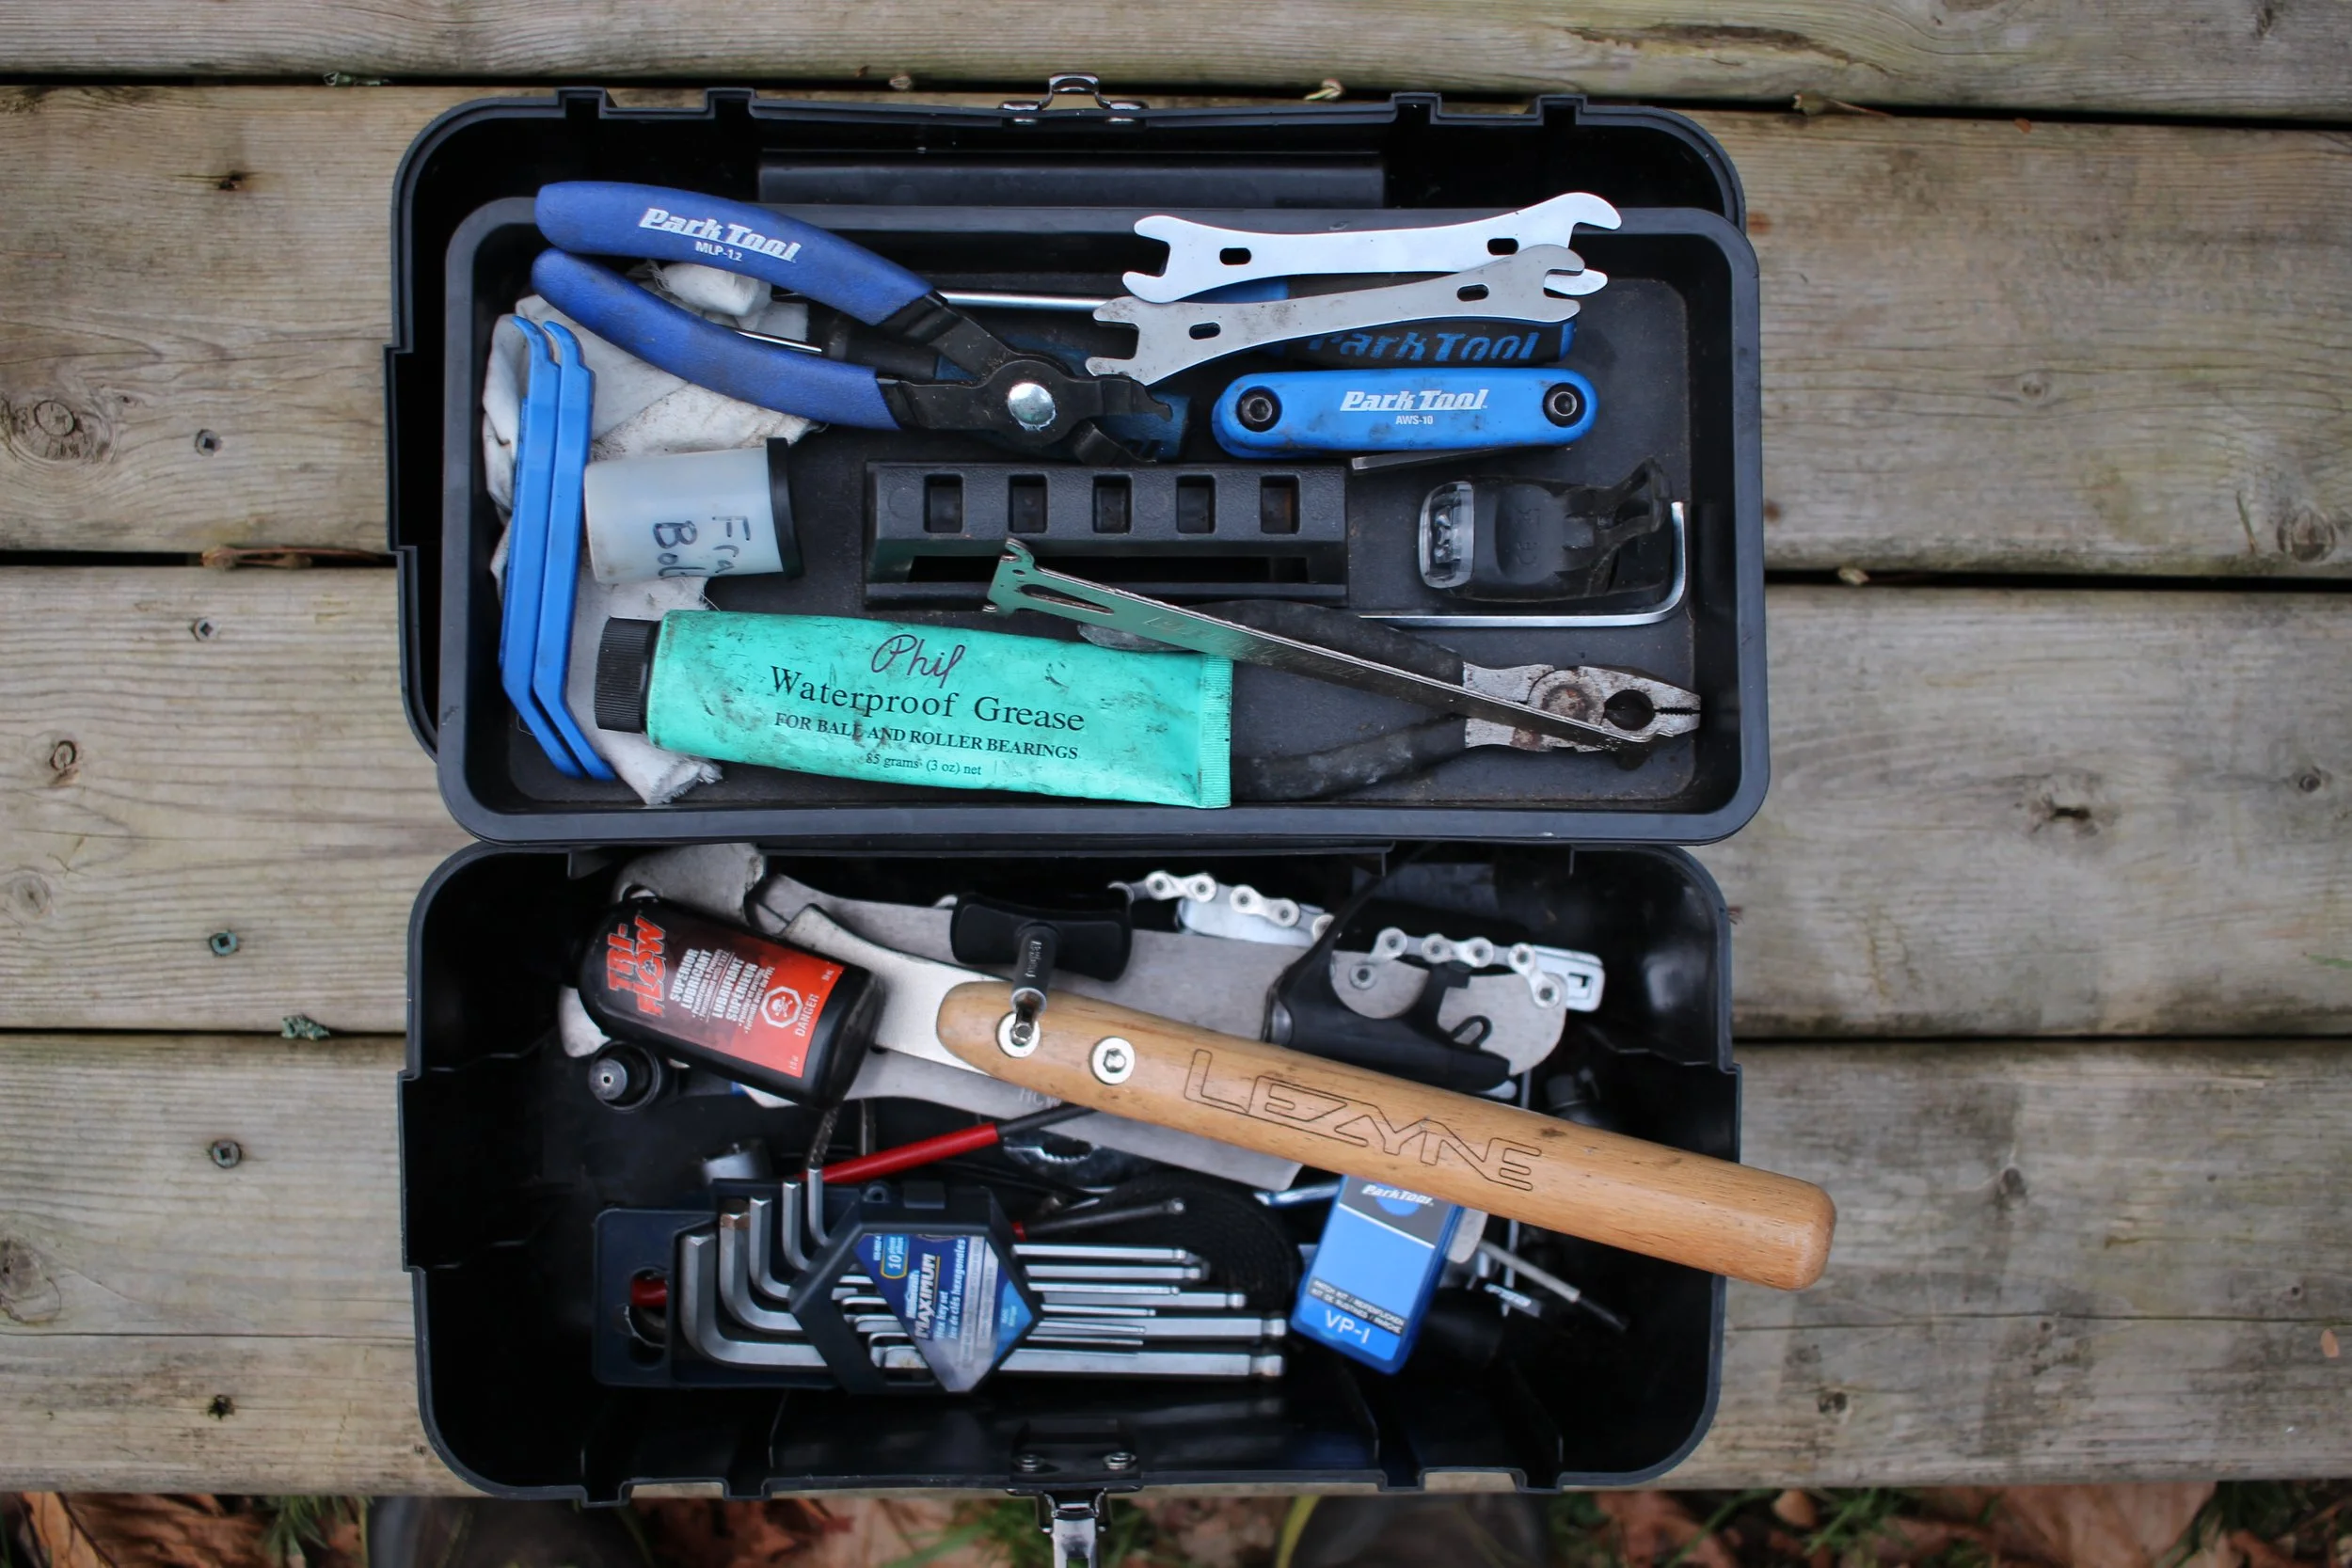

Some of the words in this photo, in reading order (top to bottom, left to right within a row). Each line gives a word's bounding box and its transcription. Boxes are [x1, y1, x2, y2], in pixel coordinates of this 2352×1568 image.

[639, 208, 728, 241] Park
[725, 222, 803, 263] Tool
[1434, 331, 1541, 362] Tool
[1339, 390, 1416, 412] Park
[1413, 388, 1488, 411] Tool
[1395, 414, 1434, 426] AWS-10
[869, 633, 966, 689] Phil
[771, 664, 960, 719] Waterproof
[973, 695, 1085, 732] Grease
[774, 712, 813, 732] FOR
[817, 719, 864, 739] BALL
[866, 725, 907, 743] AND
[910, 730, 983, 752] ROLLER
[986, 737, 1079, 760] BEARINGS
[866, 752, 880, 765] 85
[882, 757, 919, 772] grams
[926, 758, 939, 773] (3
[941, 760, 961, 775] oz)
[963, 763, 982, 775] net
[670, 948, 699, 1002] SUPERIOR
[680, 948, 713, 1010] LUBRICANT
[711, 957, 745, 1019] LUBRIFIANT
[793, 993, 819, 1037] DANGER
[1183, 1048, 1543, 1193] LEZYNE
[887, 1254, 903, 1270] 10
[950, 1239, 966, 1295] hexagonales
[914, 1253, 936, 1339] MAXIMUM
[935, 1304, 949, 1320] key
[938, 1291, 948, 1304] set
